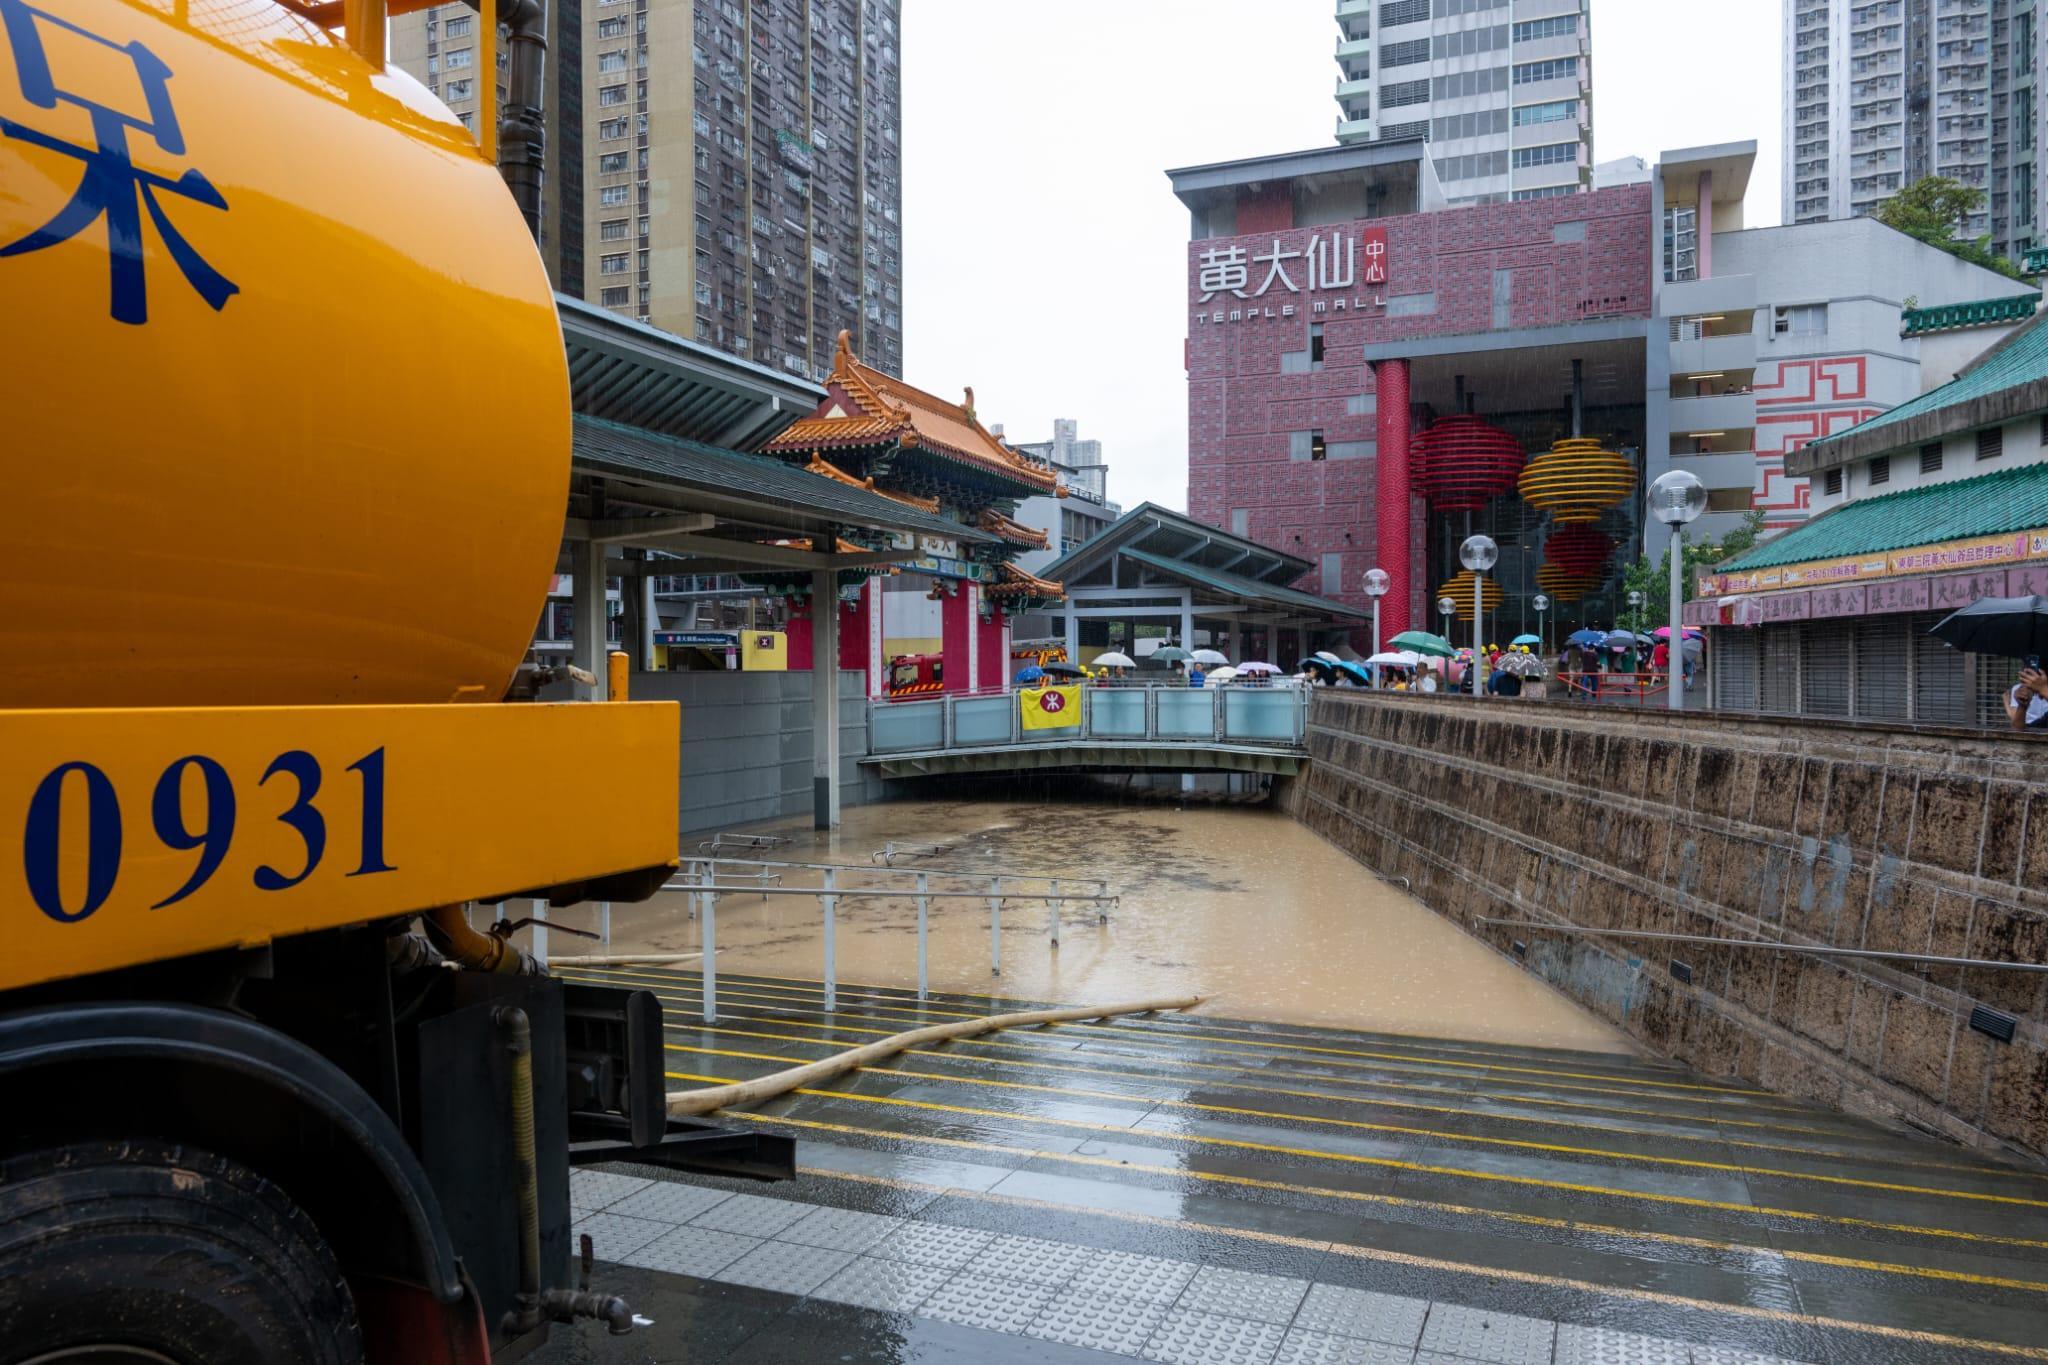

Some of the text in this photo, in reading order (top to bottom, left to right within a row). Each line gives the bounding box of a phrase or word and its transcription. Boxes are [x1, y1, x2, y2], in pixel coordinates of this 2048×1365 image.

[1366, 240, 1384, 281] 中心
[1197, 295, 1387, 324] TEMPLE MALL
[23, 745, 399, 925] 0931
